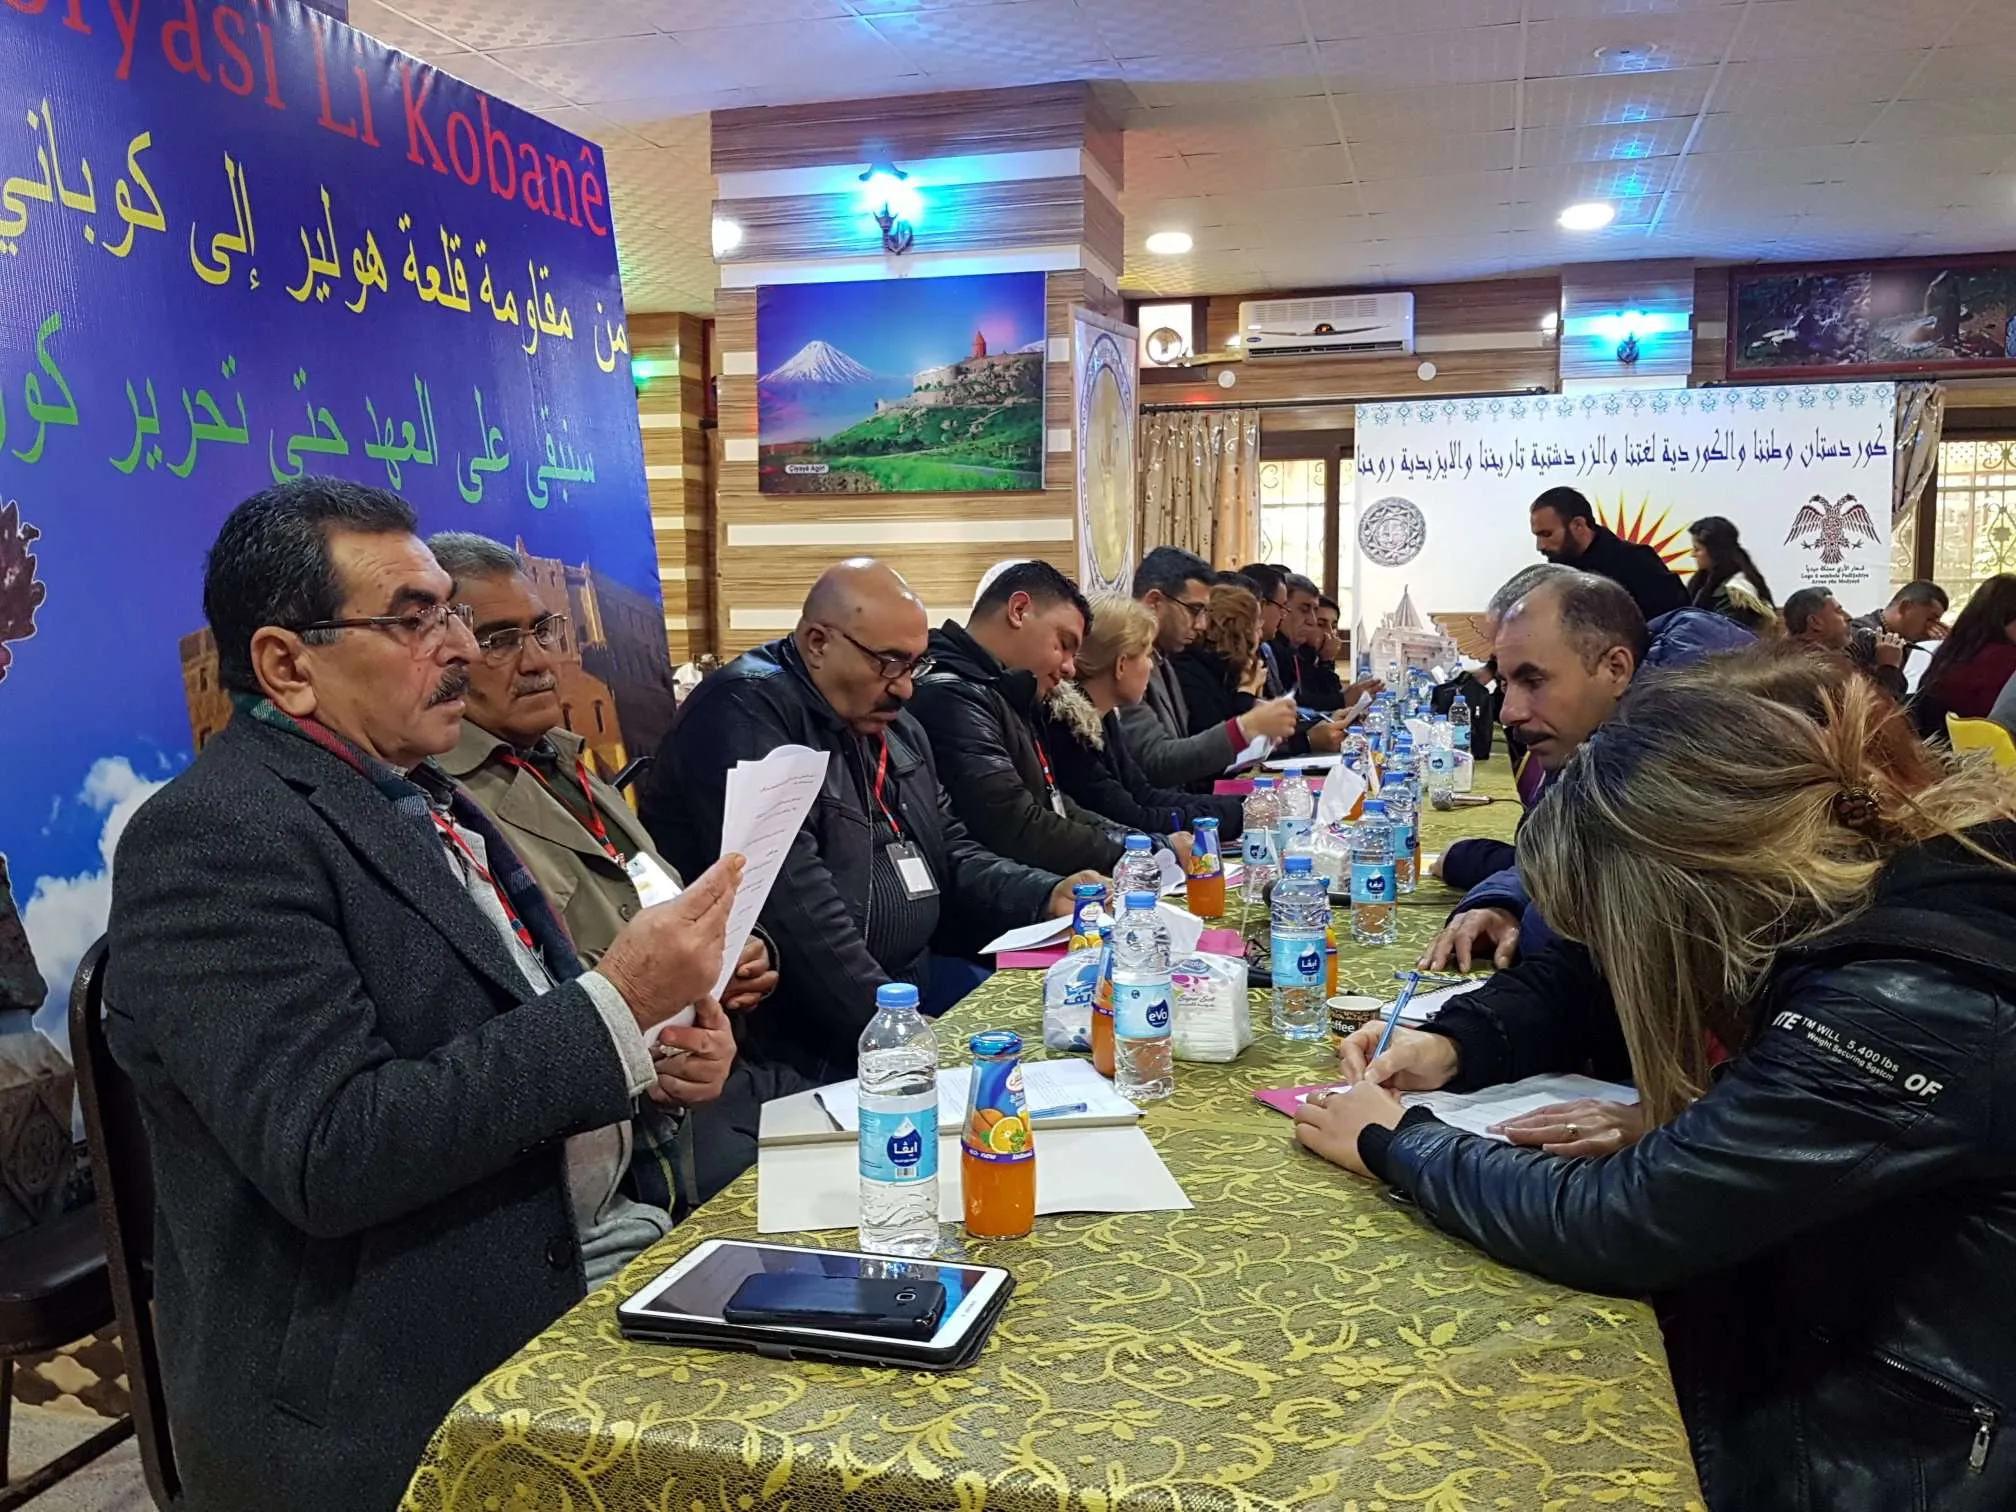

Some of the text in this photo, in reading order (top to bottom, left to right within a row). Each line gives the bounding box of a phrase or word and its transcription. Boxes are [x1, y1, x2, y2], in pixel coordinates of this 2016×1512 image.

[309, 18, 380, 147] Li
[402, 62, 608, 236] Kobanê
[0, 97, 628, 373] من مقاومة قلعة هولير إلى كوباني
[109, 354, 249, 478] تحرير
[269, 368, 349, 484] حتى
[364, 373, 438, 490] العهد
[457, 384, 510, 504] على
[526, 404, 596, 510] سنبقى
[1356, 444, 1394, 483] روحنا
[1479, 436, 1525, 479] تاريخنا
[1624, 431, 1656, 468] لغتنا
[1661, 427, 1747, 473] والكوردية
[1753, 427, 1793, 471] وطننا
[1799, 423, 1888, 470] كوردستان
[1807, 1031, 1833, 1049] Weight
[1817, 1024, 1840, 1042] WILL
[1846, 1040, 1880, 1062] 5,400
[1881, 1057, 1899, 1073] lbs
[1904, 1073, 1944, 1097] OF
